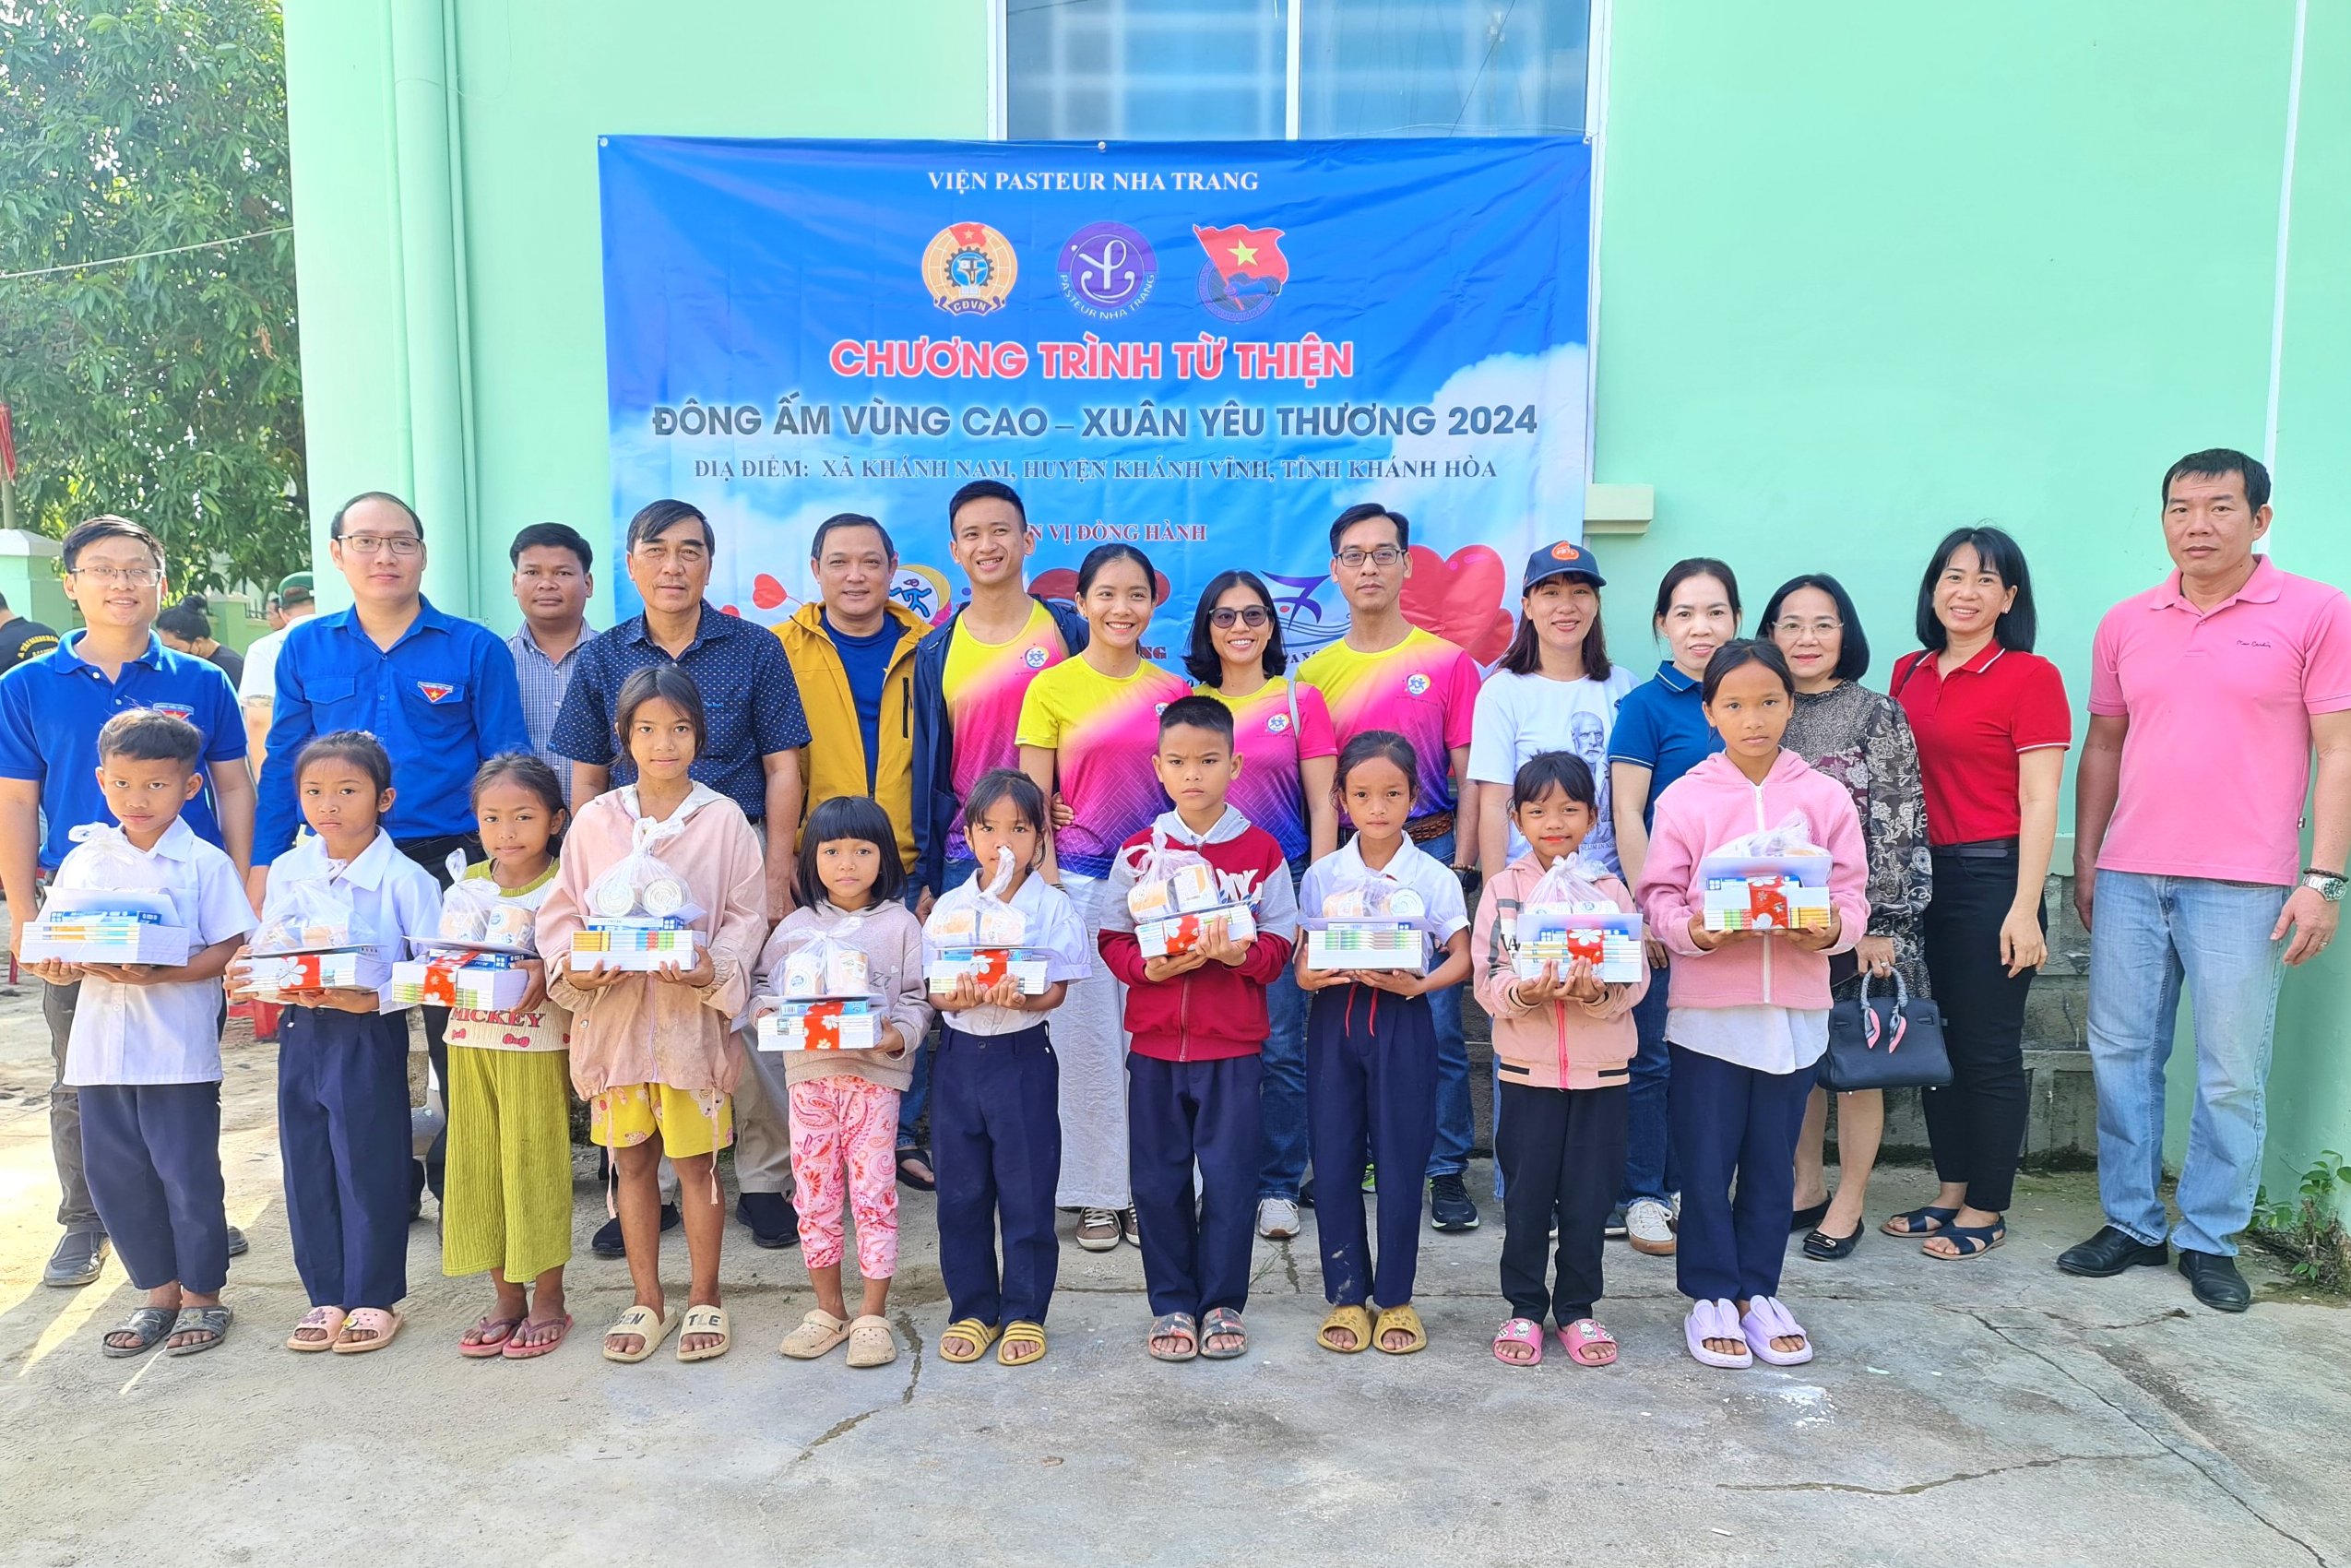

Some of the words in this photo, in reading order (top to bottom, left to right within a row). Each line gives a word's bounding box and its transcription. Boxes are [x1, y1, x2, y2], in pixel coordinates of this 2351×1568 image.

[928, 169, 987, 195] VIỆN
[995, 172, 1106, 190] PASTEUR
[1112, 172, 1166, 190] NHA
[1170, 172, 1258, 190] TRANG
[1060, 274, 1098, 317] PASTEUR
[1099, 309, 1128, 319] NHA
[1127, 274, 1155, 311] TRANG
[829, 336, 1028, 378] CHƯƠNG
[1039, 331, 1162, 379] TRÌNH
[1173, 332, 1228, 379] TỪ
[1234, 331, 1354, 388] THIỆN
[653, 398, 762, 436] ĐÔNG
[773, 391, 830, 435] ẤM
[842, 398, 951, 436] VÙNG
[962, 407, 1049, 436] CAO
[1082, 399, 1188, 436] XUÂN
[1200, 399, 1265, 436] YÊU
[1276, 401, 1437, 436] THƯƠNG
[1447, 404, 1538, 435] 2024
[821, 455, 855, 477] XÃ
[861, 454, 947, 478] KHÁNH
[954, 460, 1016, 481] NAM,
[1023, 457, 1106, 483] HUYỆN
[1113, 456, 1202, 479] KHÁNH
[1206, 456, 1275, 481] VĨNH,
[1280, 455, 1342, 479] TỈNH
[1348, 455, 1436, 479] KHÁNH
[1444, 454, 1499, 478] HÒA
[1048, 523, 1072, 545] VỊ
[1076, 519, 1140, 541] ĐỒNG
[1144, 519, 1208, 541] HÀNH
[450, 1006, 546, 1028] MICKEY
[688, 1313, 721, 1326] TLE
